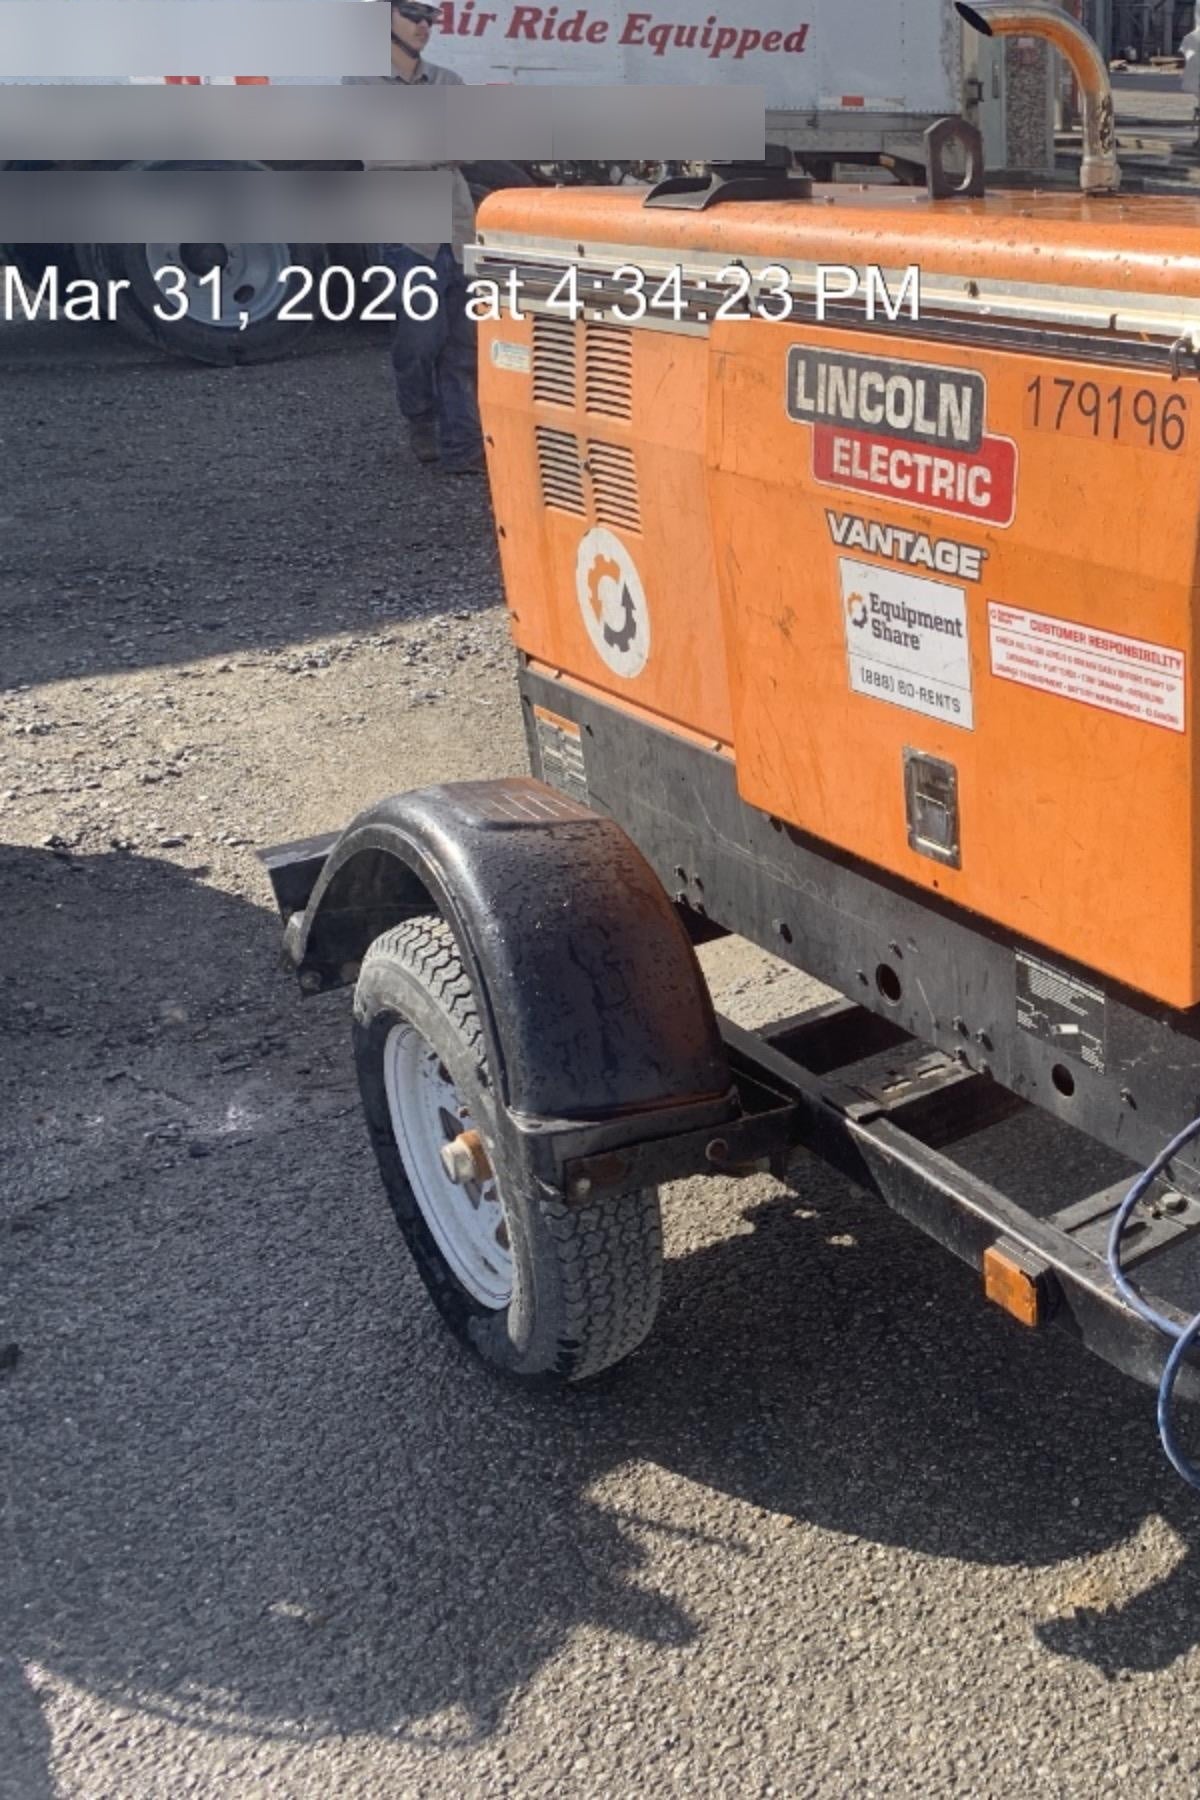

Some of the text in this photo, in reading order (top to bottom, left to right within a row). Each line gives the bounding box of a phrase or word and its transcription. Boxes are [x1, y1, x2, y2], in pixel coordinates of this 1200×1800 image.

[505, 5, 609, 44] Ride
[618, 13, 810, 59] Equipped
[795, 358, 972, 441] LINCOLN
[1026, 374, 1188, 450] 179196
[832, 437, 992, 507] ELECTRIC
[826, 510, 986, 581] VANTAGE
[868, 592, 964, 638] Equipment
[871, 615, 921, 651] Share
[1029, 618, 1087, 645] CUSTOMER
[860, 667, 895, 694] (888)
